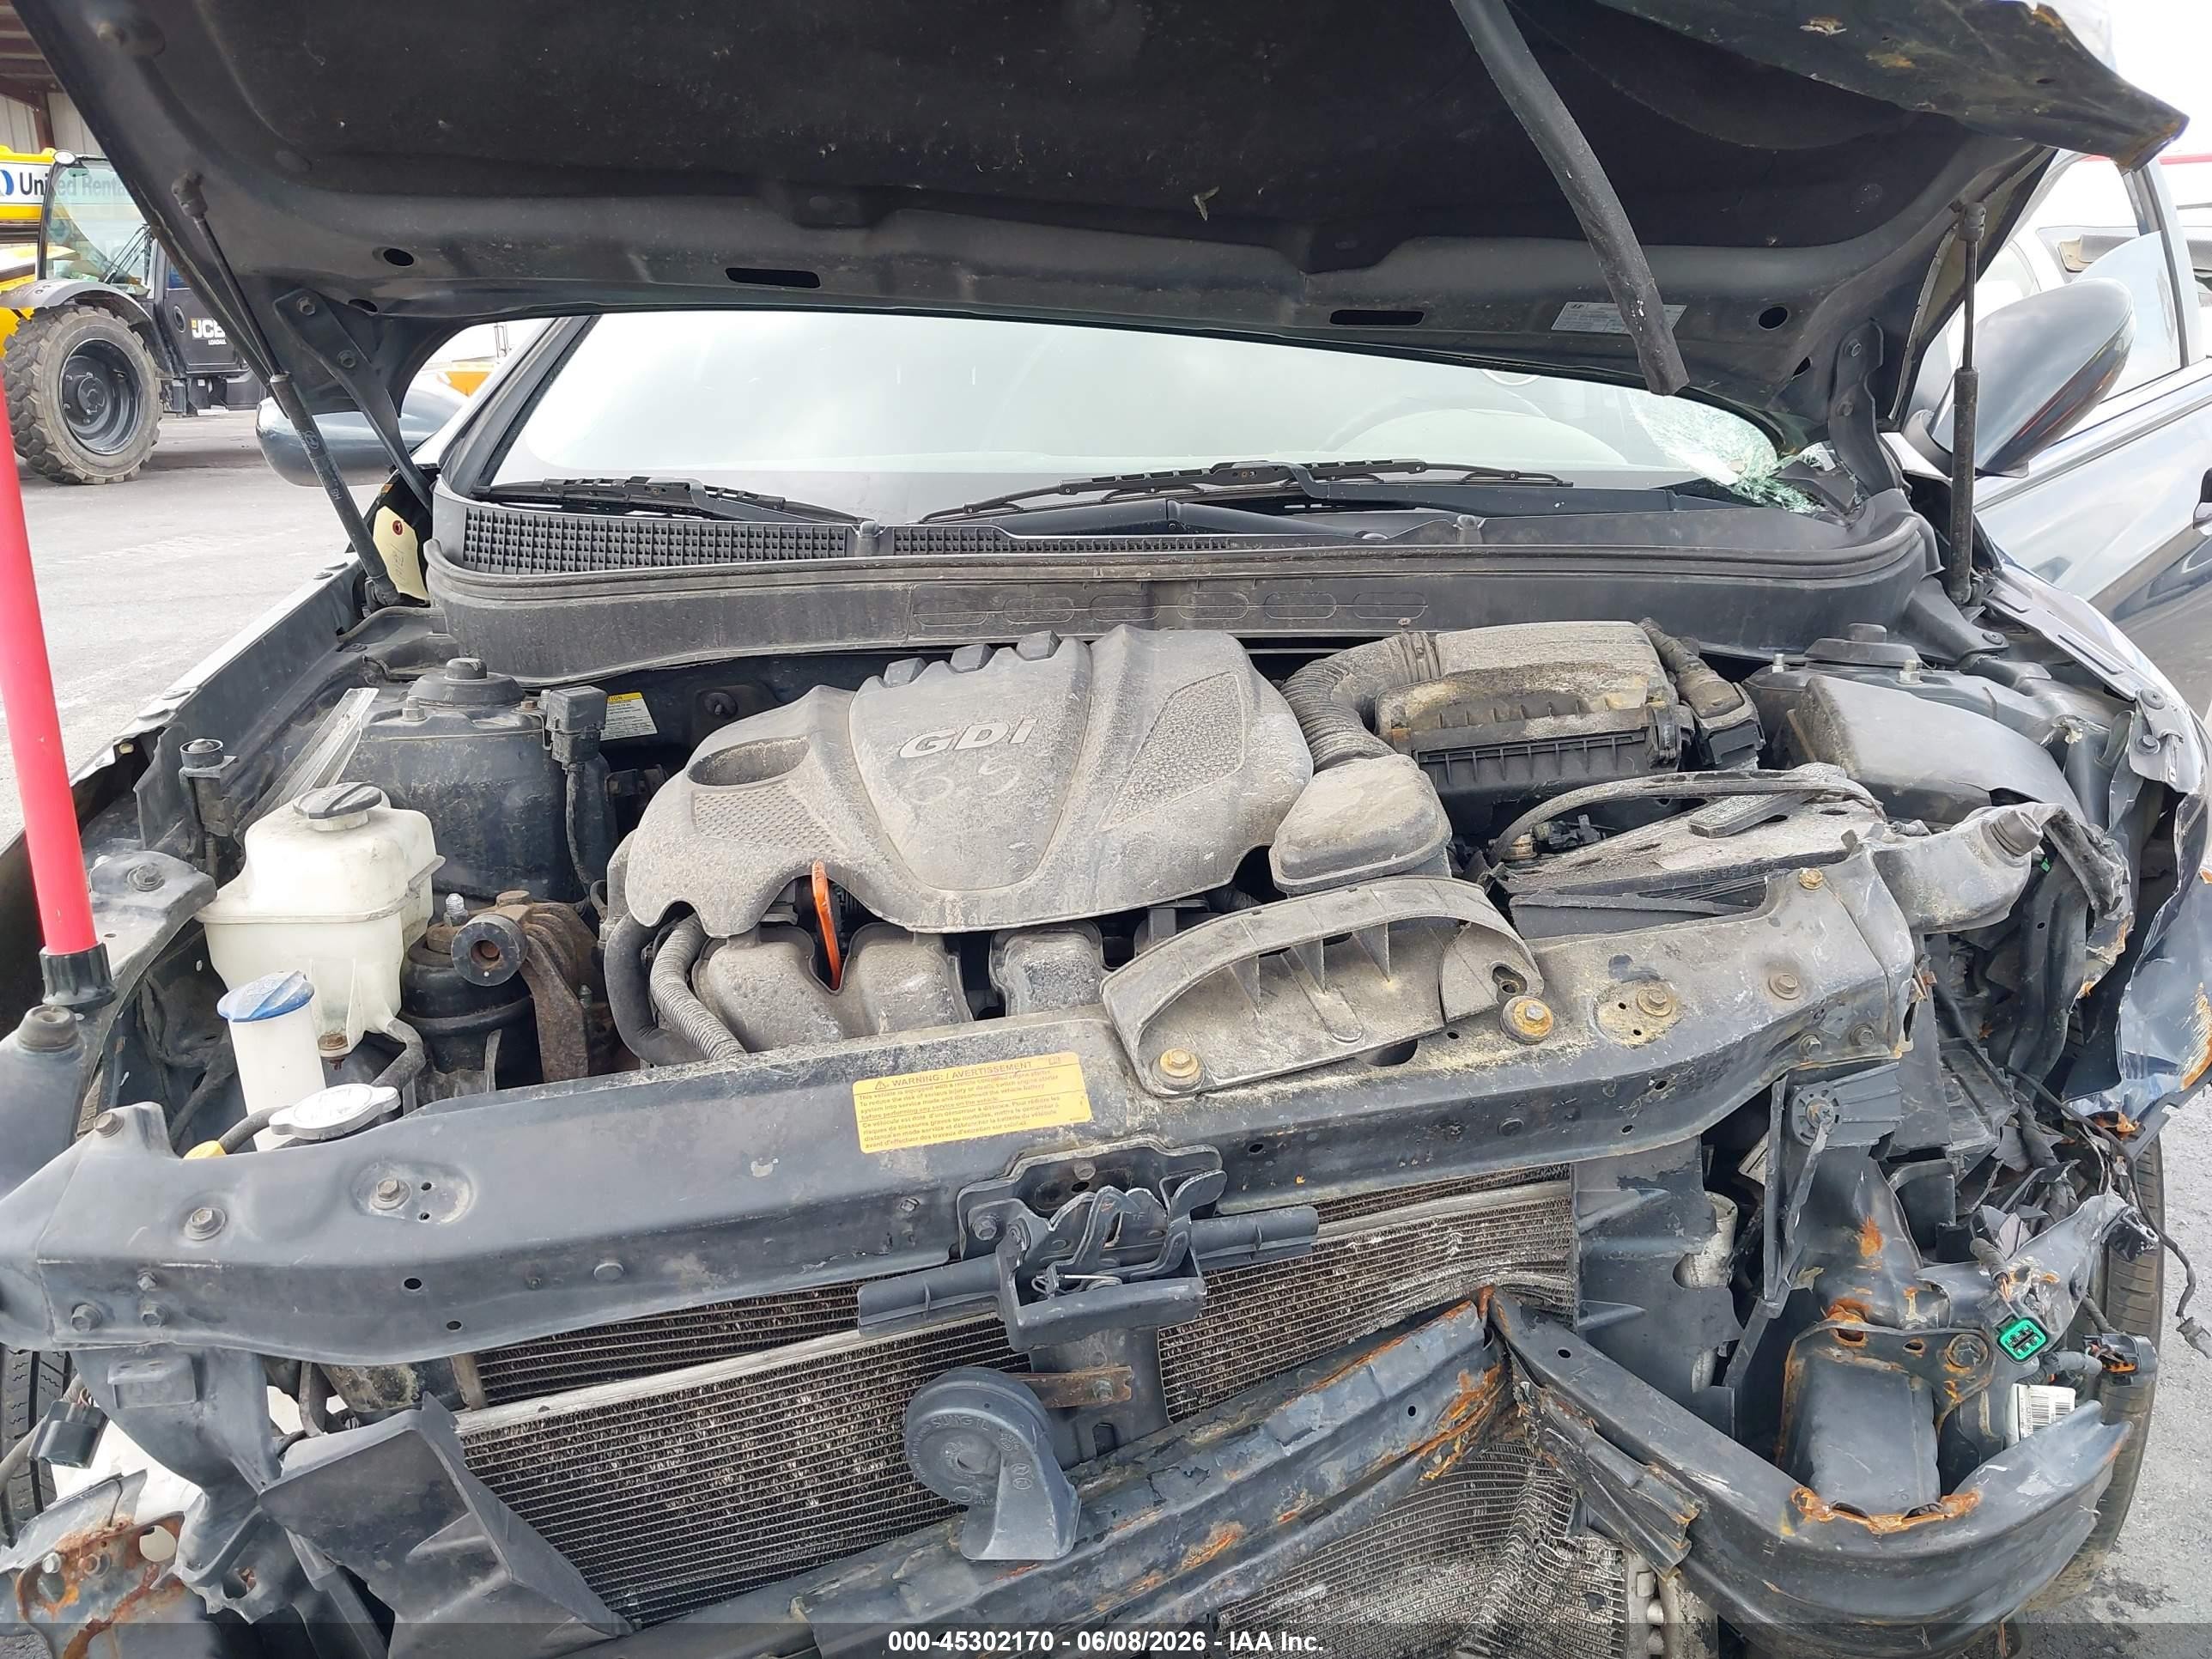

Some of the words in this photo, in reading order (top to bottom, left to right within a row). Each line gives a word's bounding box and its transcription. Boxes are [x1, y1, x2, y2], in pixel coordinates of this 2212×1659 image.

[19, 172, 76, 196] Unied
[82, 174, 129, 197] Renta
[191, 319, 226, 338] JCB
[891, 1073, 943, 1086] WARNING:
[951, 1061, 1031, 1078] AVERTISSEMENT
